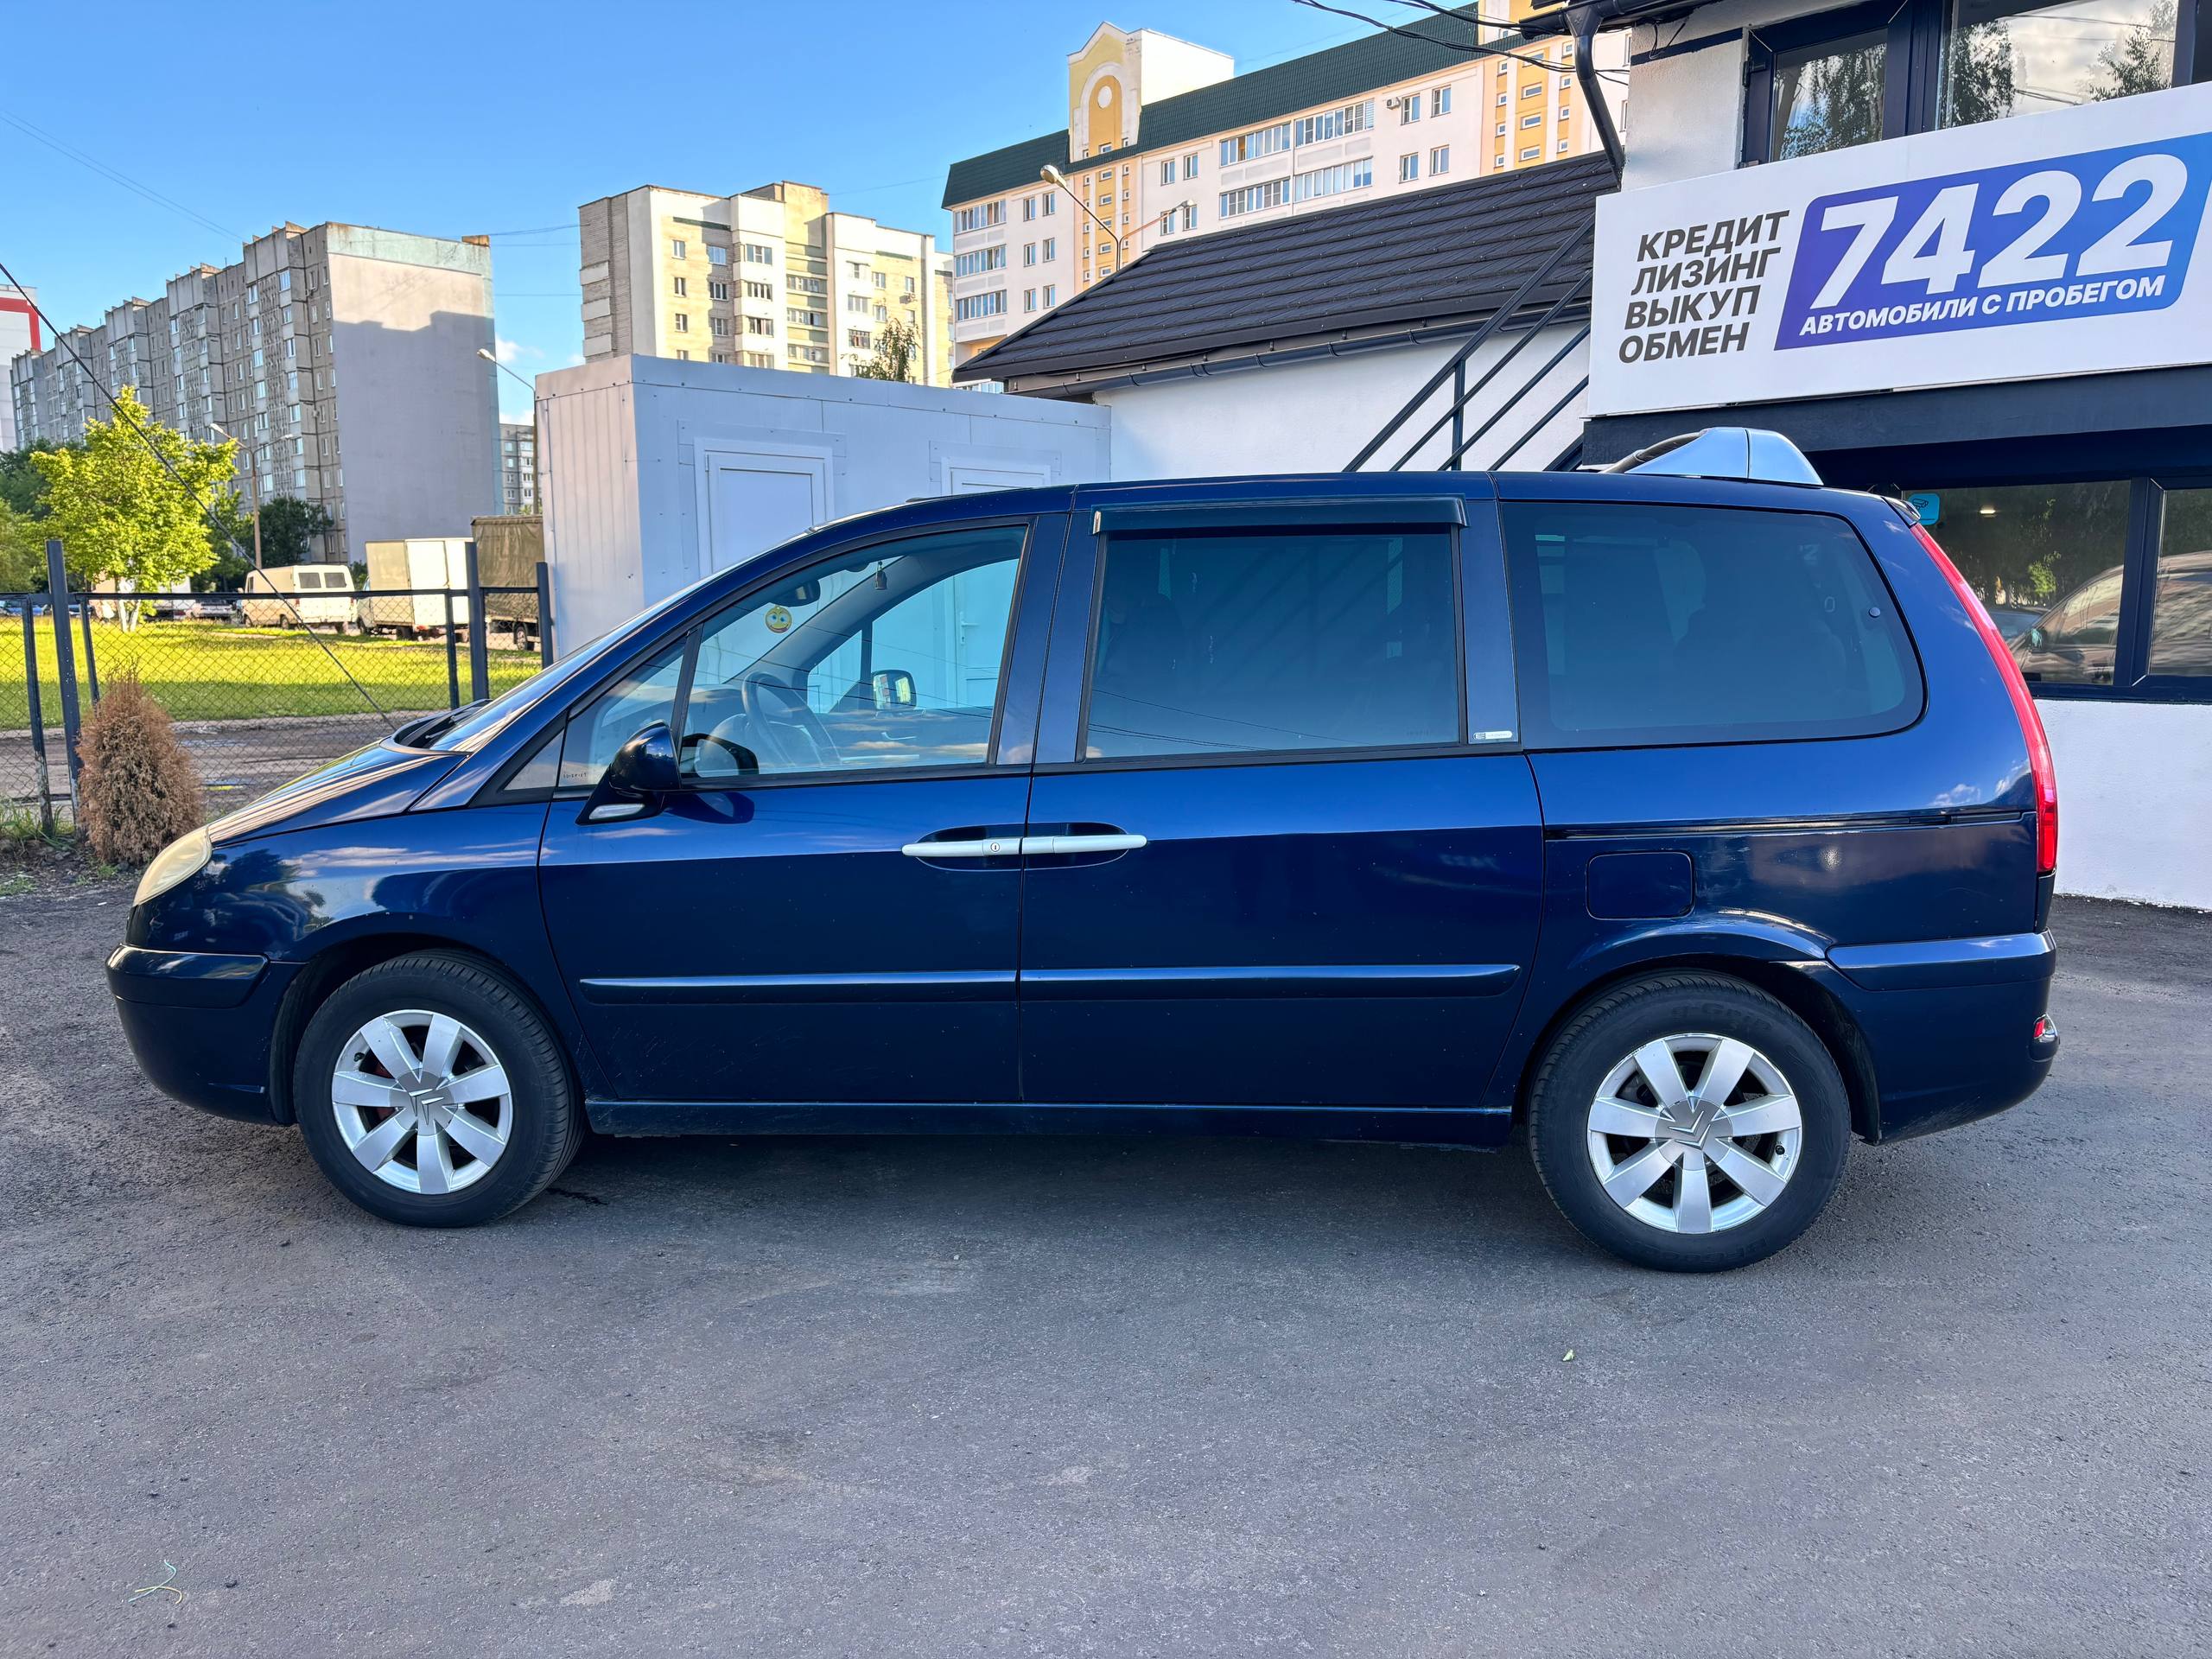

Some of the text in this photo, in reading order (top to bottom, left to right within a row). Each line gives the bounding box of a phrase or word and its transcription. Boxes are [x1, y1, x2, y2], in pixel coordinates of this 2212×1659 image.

[1637, 210, 1789, 262] КРЕДИТ
[1810, 154, 2188, 309] 7422
[1630, 247, 1781, 296] ЛИЗИНГ
[1624, 285, 1761, 330] ВЫКУП
[1799, 275, 2166, 336] АВТОМОБИЛИ С ПРОБЕГОМ
[1618, 322, 1750, 364] ОБМЕН
